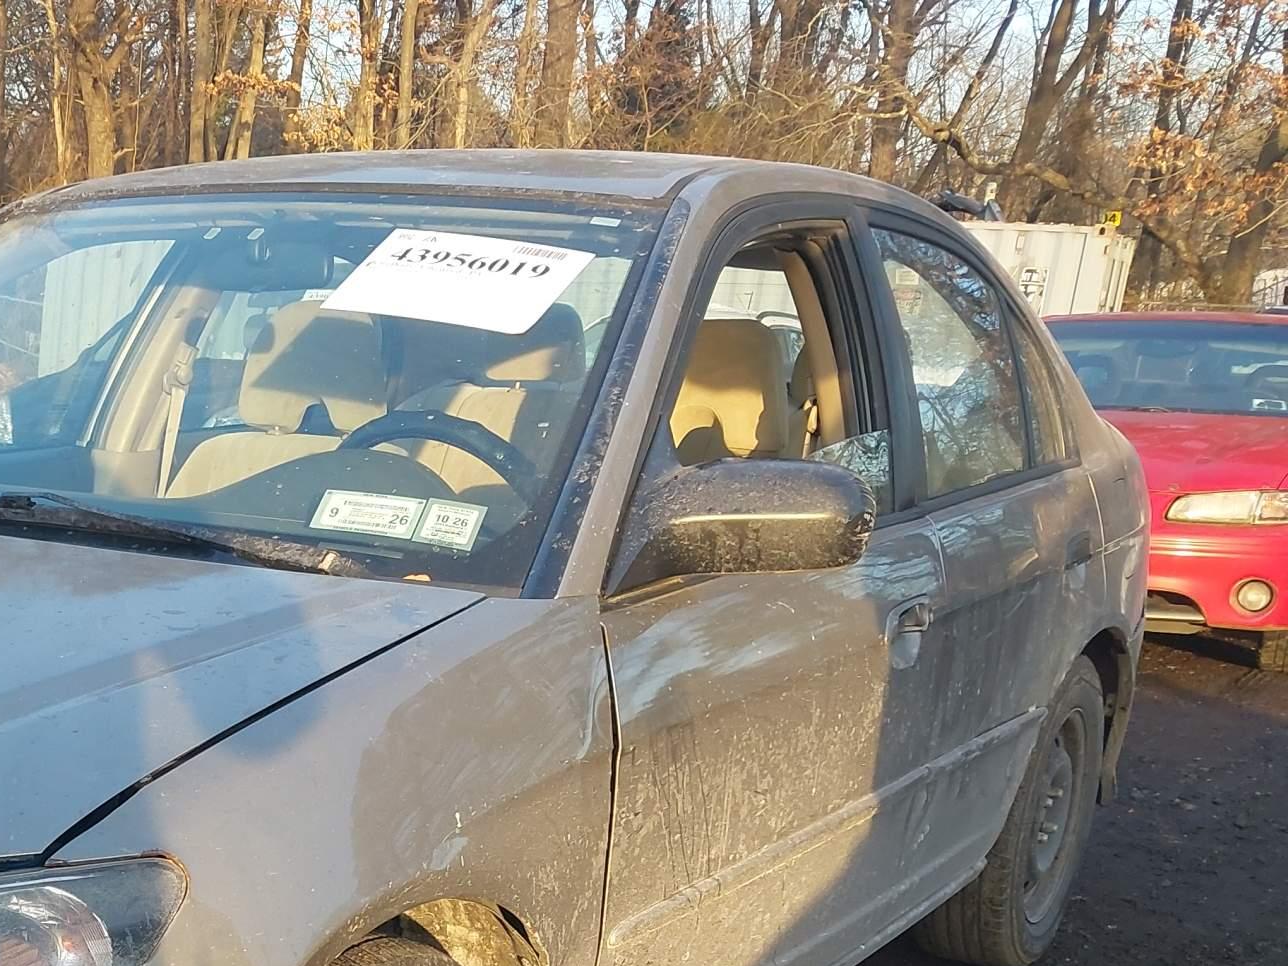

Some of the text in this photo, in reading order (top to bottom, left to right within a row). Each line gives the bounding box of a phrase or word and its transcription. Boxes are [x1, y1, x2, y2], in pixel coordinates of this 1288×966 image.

[391, 247, 551, 278] 43956019
[328, 507, 340, 518] 9
[388, 513, 409, 526] 26
[435, 514, 450, 524] 10
[452, 517, 469, 527] 26
